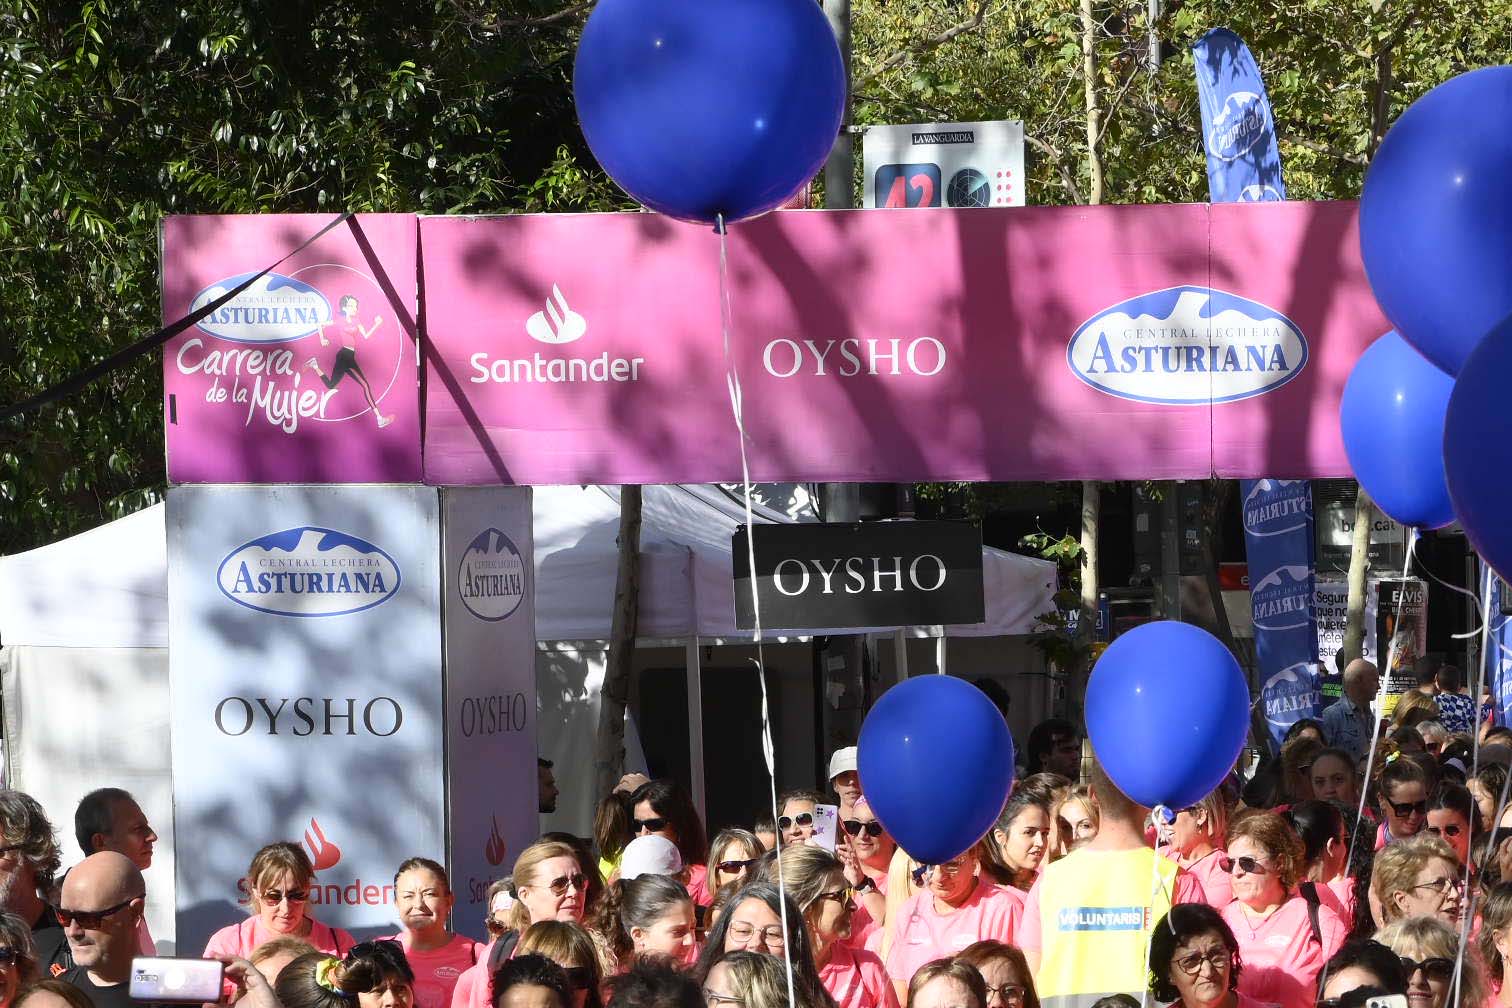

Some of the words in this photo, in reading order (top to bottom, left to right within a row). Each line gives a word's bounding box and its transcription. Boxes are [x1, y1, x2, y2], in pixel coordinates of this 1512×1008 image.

[1123, 328, 1197, 339] CENTRAL
[1205, 327, 1280, 337] LECHERA
[177, 338, 296, 376] Carrera
[471, 352, 644, 384] Santander
[763, 336, 946, 378] OYSHO
[1086, 331, 1290, 374] ASTURIANA
[206, 377, 228, 403] de
[232, 378, 248, 403] la
[246, 376, 338, 434] Mujer
[232, 561, 388, 594] ASTURIANA
[259, 559, 317, 568] CENTRAL
[323, 558, 381, 567] LECHERA
[463, 561, 522, 598] ASTURIANA
[773, 554, 947, 596] OYSHO
[215, 696, 403, 738] OYSHO
[461, 691, 527, 738] OYSHO
[237, 878, 388, 906] Sander
[1059, 911, 1141, 926] VOLUNTARIS
